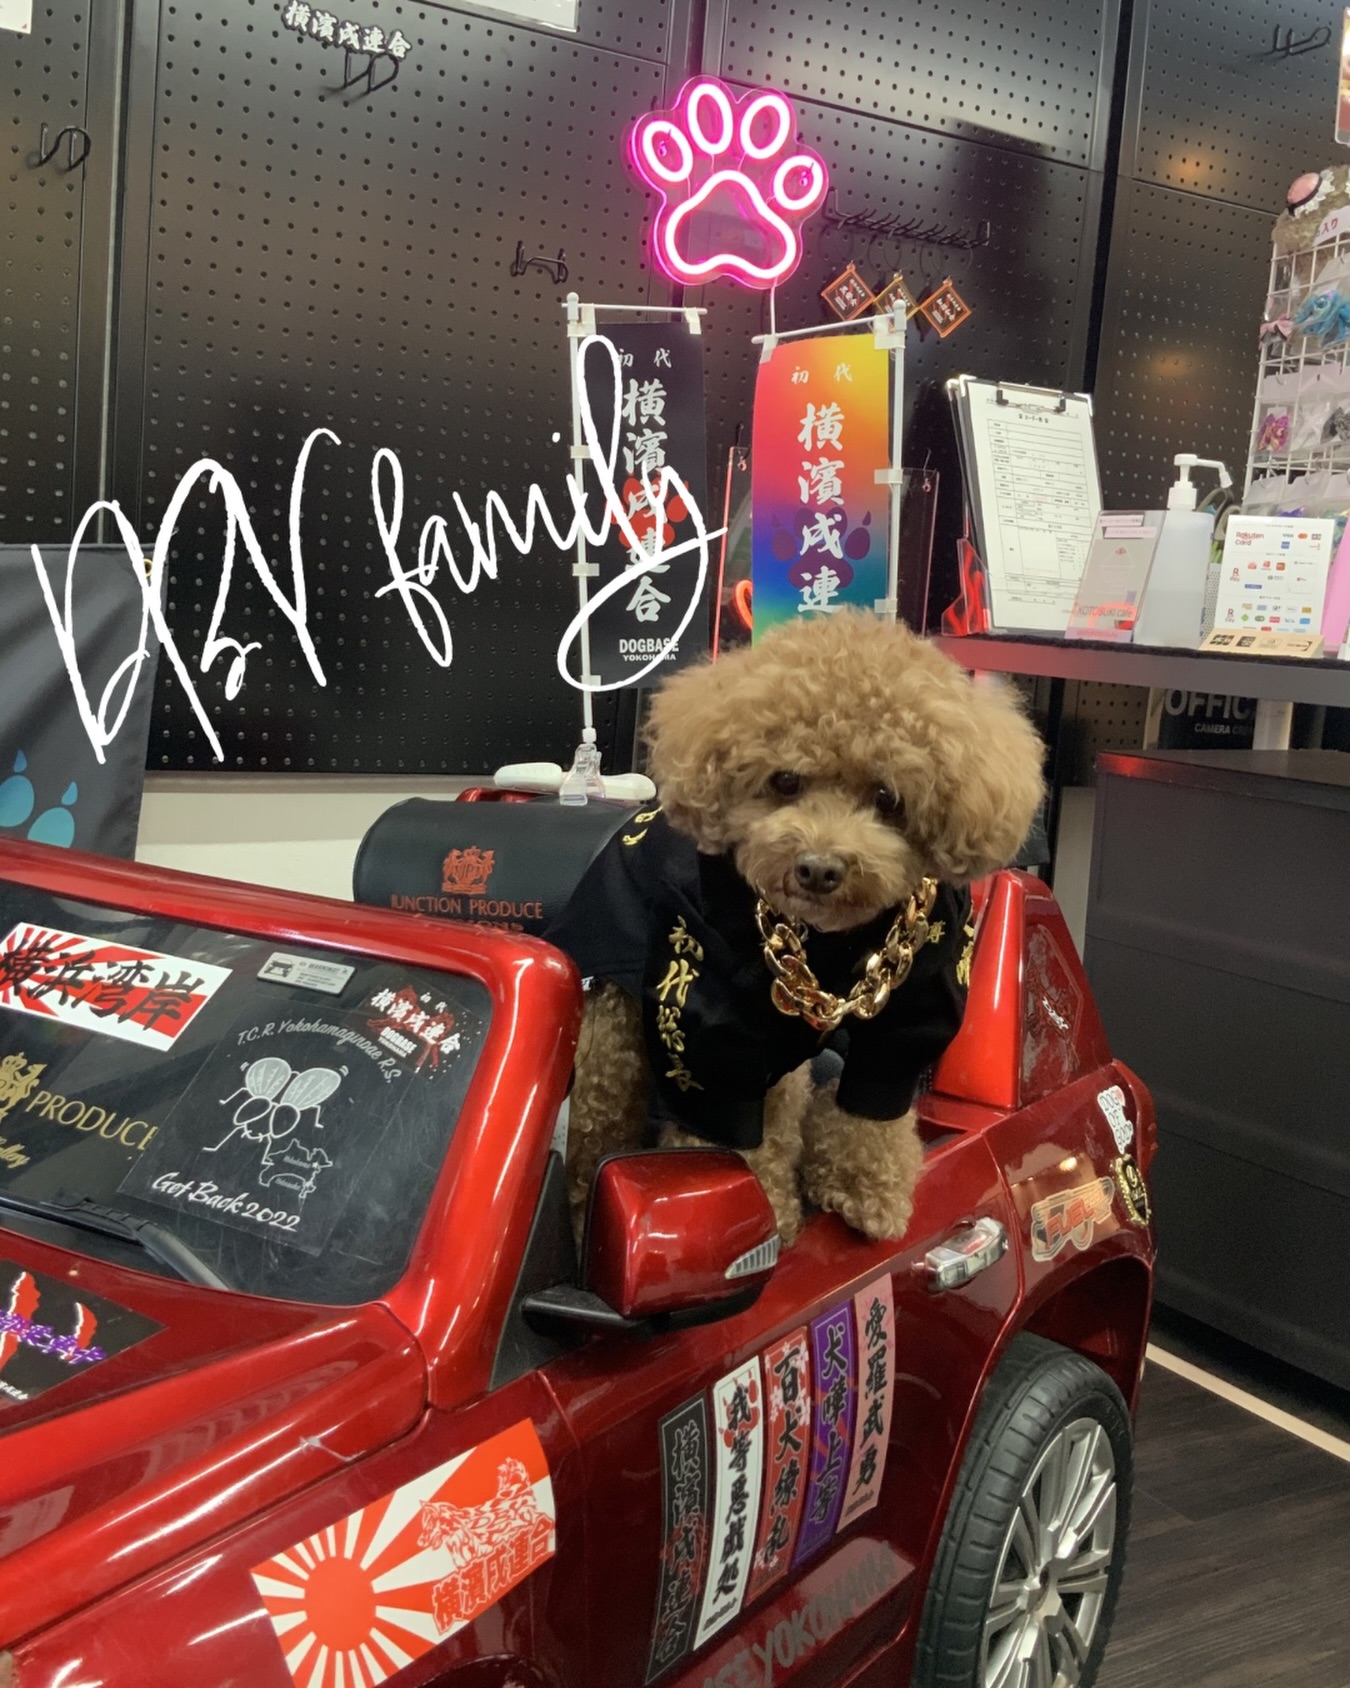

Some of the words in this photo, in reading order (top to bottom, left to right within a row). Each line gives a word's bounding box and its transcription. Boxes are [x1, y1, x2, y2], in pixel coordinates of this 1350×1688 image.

[1236, 531, 1264, 540] Rakuten
[622, 653, 677, 661] YOKOHMA
[1194, 723, 1231, 735] CAMERA
[469, 899, 543, 919] PRODUCE
[0, 938, 205, 1030] 横浜湾岸
[25, 1090, 159, 1150] PRODUCE
[152, 1172, 195, 1198] Get
[188, 1181, 249, 1214] Back
[241, 1202, 300, 1232] 2022
[1046, 1197, 1096, 1250] FUEL
